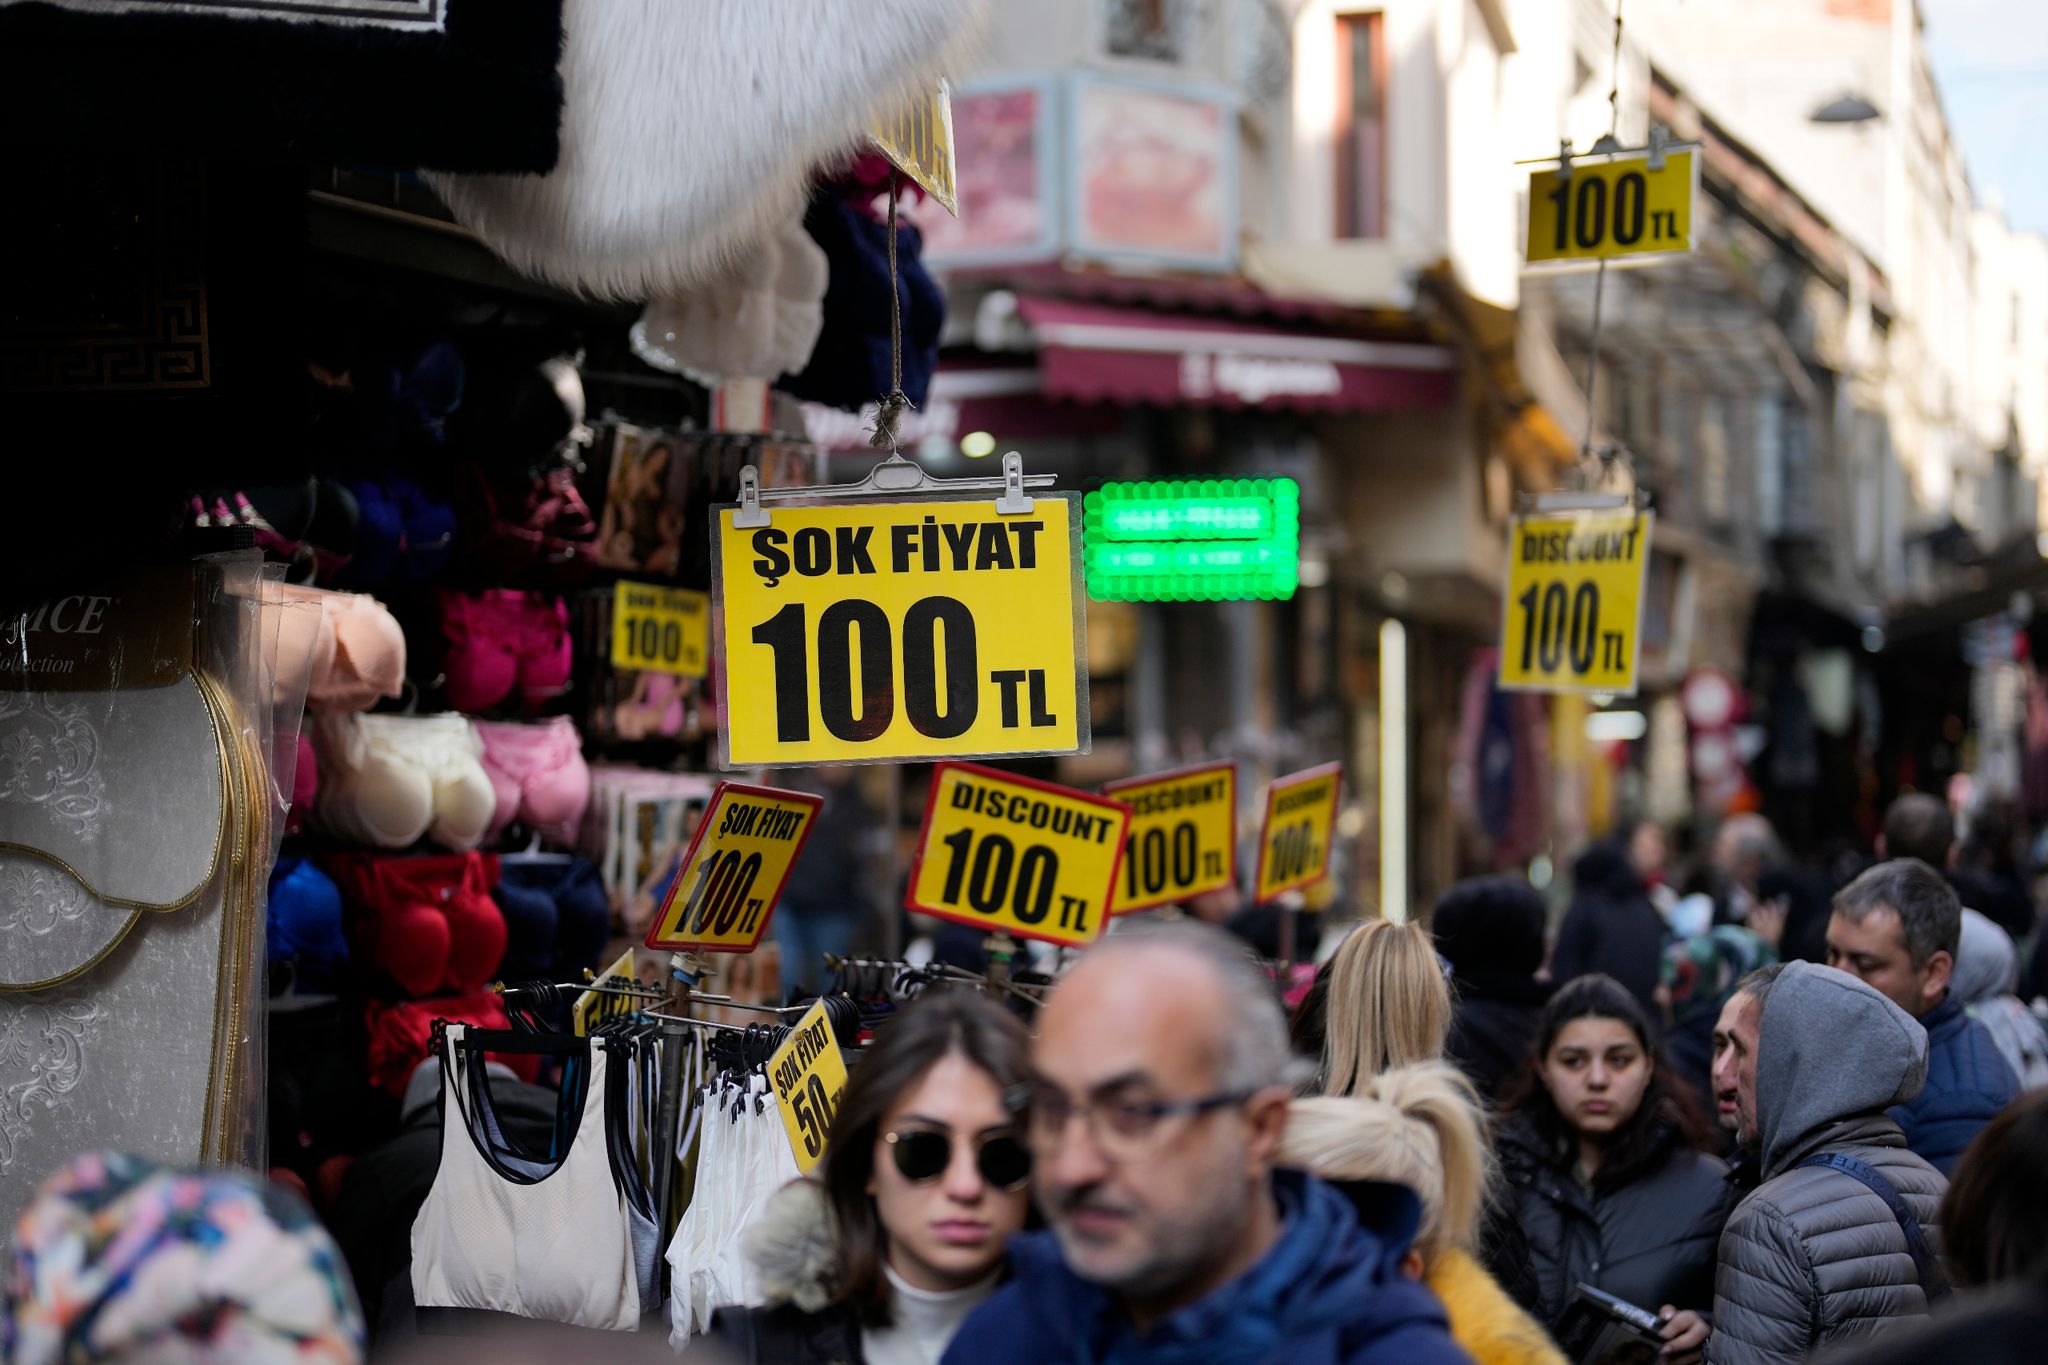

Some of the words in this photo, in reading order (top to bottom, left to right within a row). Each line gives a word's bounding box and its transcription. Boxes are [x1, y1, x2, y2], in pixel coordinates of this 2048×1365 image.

[1548, 172, 1645, 250] 100
[1651, 211, 1679, 239] TL
[752, 527, 876, 587] ŞOK
[891, 516, 1044, 573] FİYAT
[0, 652, 74, 674] ollection
[625, 617, 682, 663] 100
[1519, 580, 1599, 675] 100
[1603, 631, 1625, 672] TL
[752, 596, 978, 742] 100
[991, 669, 1056, 728] TL
[719, 803, 762, 839] ŞOK
[755, 804, 805, 841] FİYAT
[951, 780, 1114, 844] DISCOUNT
[674, 850, 762, 936] 100
[737, 898, 764, 933] TL
[944, 827, 1059, 925] 100
[1059, 895, 1088, 932] TL
[1126, 821, 1197, 898] 100
[1204, 851, 1223, 879] TL
[775, 1050, 802, 1104] ŞOK
[792, 1073, 835, 1158] 50
